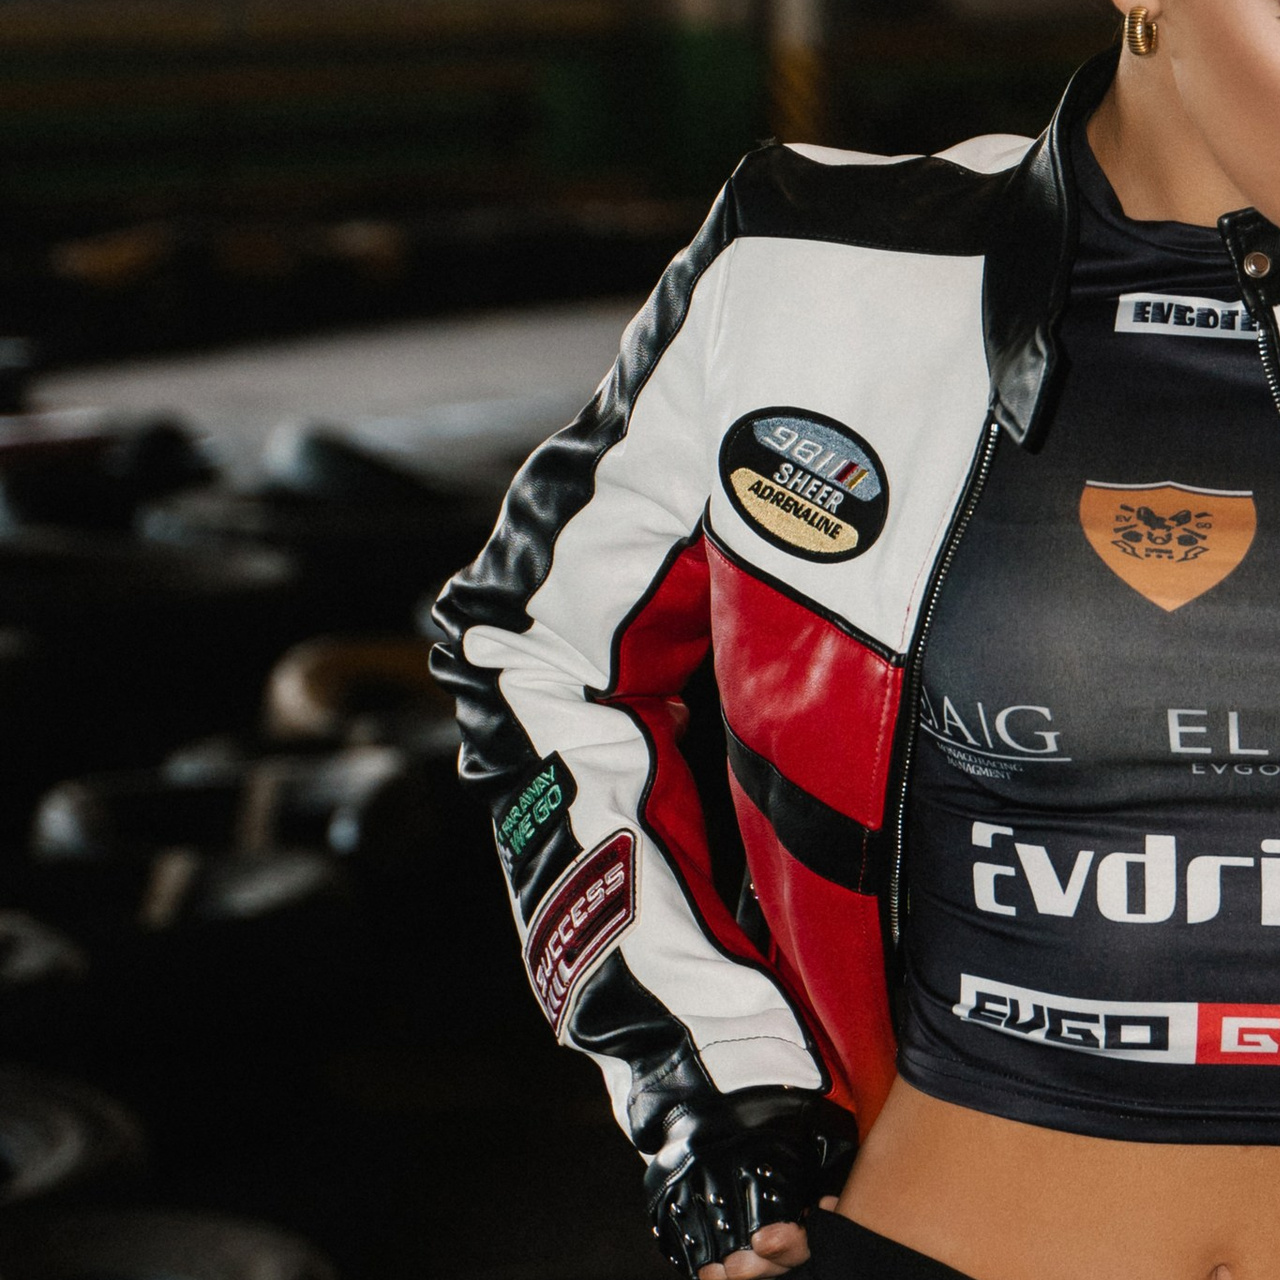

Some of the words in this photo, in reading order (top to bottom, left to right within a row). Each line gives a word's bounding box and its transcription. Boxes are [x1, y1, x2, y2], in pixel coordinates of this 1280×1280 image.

[748, 479, 843, 540] ADRENALINE
[773, 462, 844, 514] SHEER
[1191, 763, 1280, 776] EVGO
[532, 784, 563, 825] GO
[536, 861, 625, 998] SUCCESS
[968, 990, 1169, 1051] EVGO
